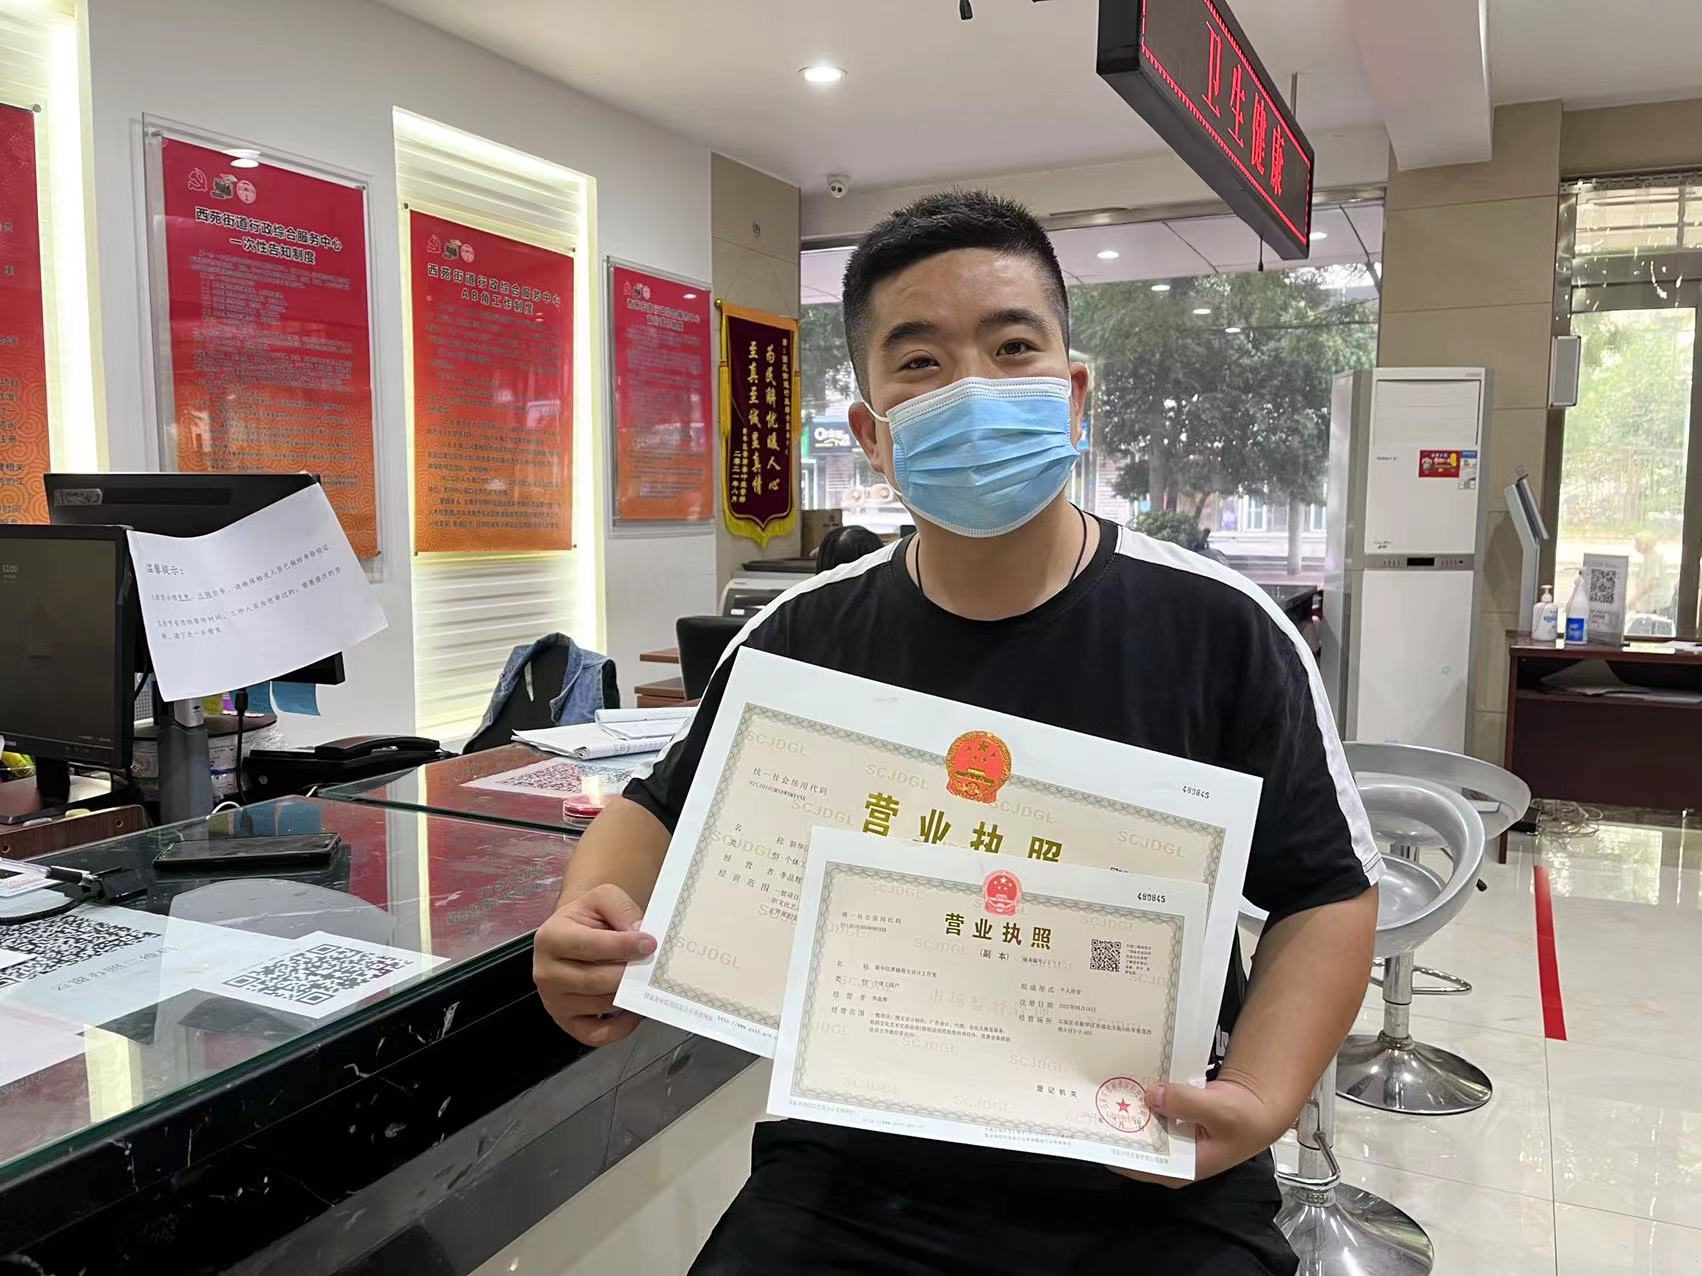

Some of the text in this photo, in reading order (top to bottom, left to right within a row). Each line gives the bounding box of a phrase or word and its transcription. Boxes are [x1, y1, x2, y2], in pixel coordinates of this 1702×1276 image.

[195, 205, 343, 252] 西苑街道行政综合服务中心
[229, 236, 317, 265] 一次性告知制度
[945, 912, 1052, 951] 营业执照
[1036, 1084, 1079, 1099] 登记机关
